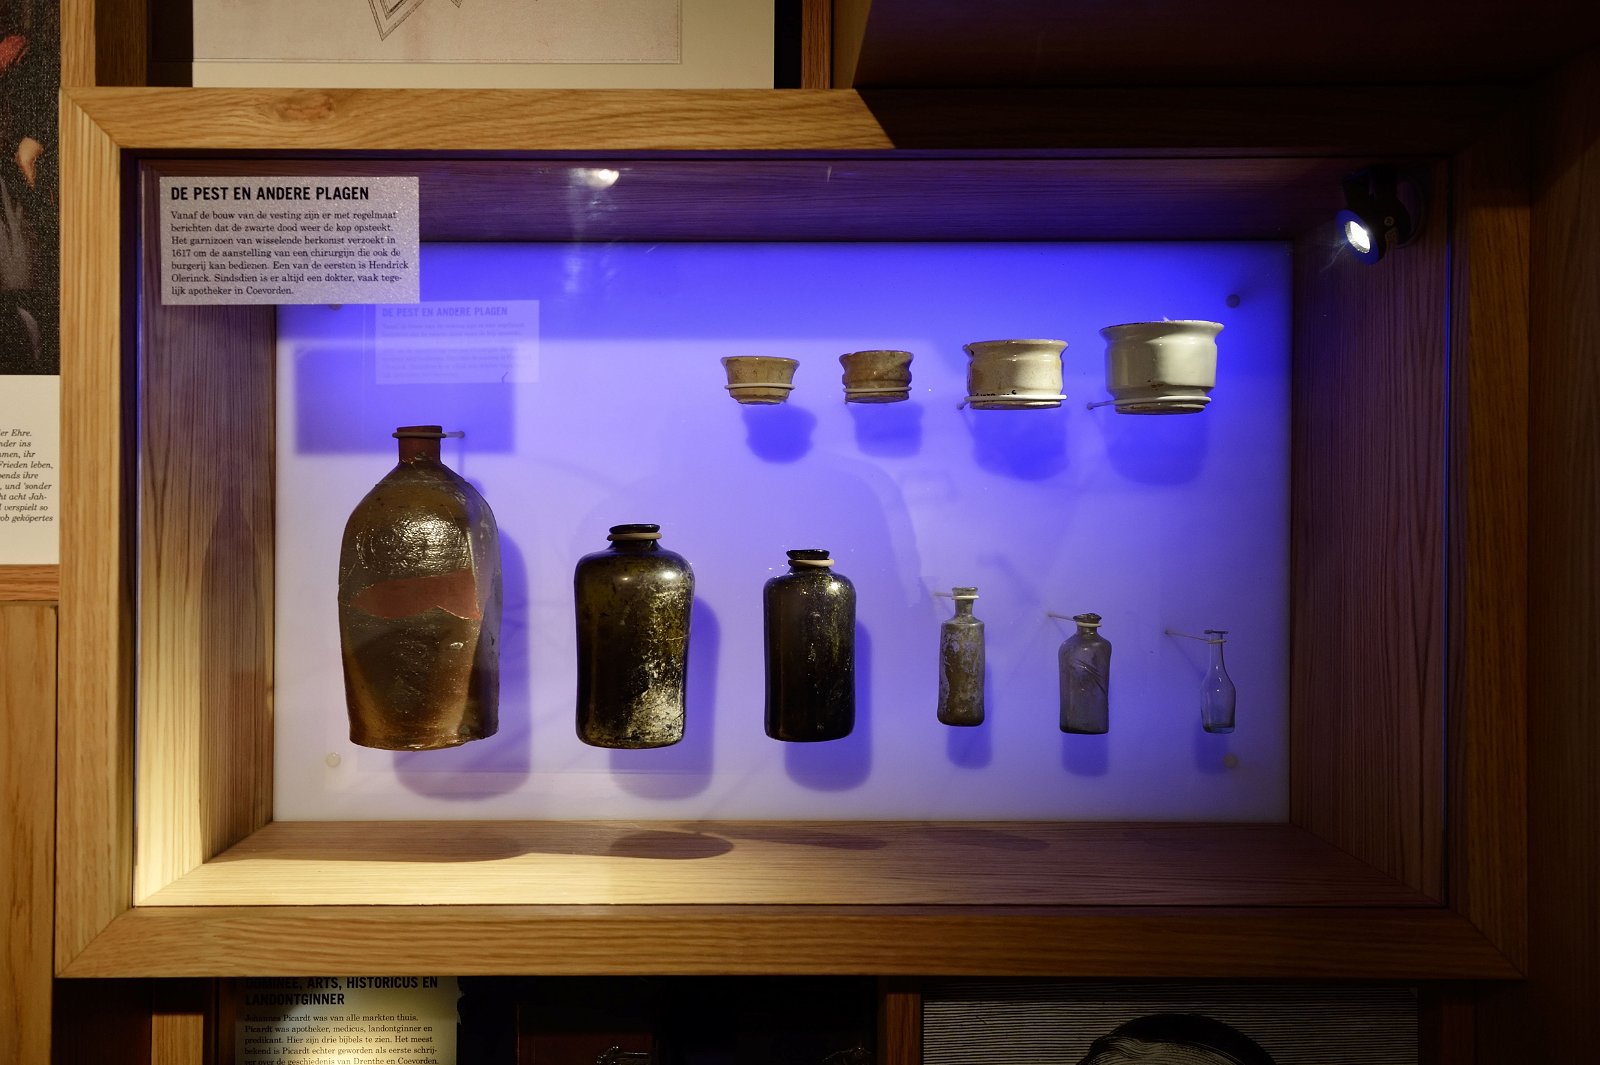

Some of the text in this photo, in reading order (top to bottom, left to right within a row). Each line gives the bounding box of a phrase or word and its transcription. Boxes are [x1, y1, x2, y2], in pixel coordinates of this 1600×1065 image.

[171, 187, 369, 200] DE PEST EN ANDERE PLAGEN
[171, 211, 198, 219] Vanaf
[200, 211, 210, 219] de
[212, 211, 235, 219] bouw
[257, 211, 267, 219] de
[270, 211, 301, 221] vesting
[304, 211, 319, 221] zijn
[353, 211, 397, 221] regelmaat
[171, 223, 212, 232] berichten
[214, 223, 229, 232] dat
[231, 223, 242, 232] de
[277, 223, 298, 232] dood
[324, 223, 333, 232] de
[336, 223, 351, 234] kop
[354, 223, 393, 234] opsteekt.
[171, 236, 187, 244] Het
[190, 236, 234, 246] garnizoen
[255, 236, 302, 244] wisselende
[304, 236, 344, 244] herkomst
[348, 236, 384, 244] verzoekt
[387, 236, 396, 244] in
[172, 248, 191, 257] 1617
[209, 248, 220, 257] de
[222, 248, 272, 259] aanstelling
[310, 248, 355, 259] chirurgijn
[358, 248, 370, 257] die
[373, 248, 388, 257] ook
[390, 248, 401, 257] de
[171, 261, 206, 271] burgerij
[209, 261, 226, 269] kan
[228, 261, 270, 269] bedienen.
[273, 261, 290, 269] Een
[311, 261, 321, 269] de
[359, 261, 366, 269] is
[369, 261, 409, 269] Hendrick
[171, 274, 210, 282] Olerinck.
[214, 274, 257, 282] Sindsdien
[260, 274, 267, 282] is
[281, 274, 304, 284] altijd
[324, 274, 355, 283] dokter,
[357, 274, 378, 282] vaak
[381, 275, 402, 284] tege-
[171, 286, 294, 296] lijk apotheker in Coevorden.
[31, 461, 53, 469] leben,
[4, 504, 37, 512] verspielt
[11, 514, 53, 523] geköpertes
[307, 977, 342, 990] ARTS,
[347, 976, 418, 988] HISTORICUS
[423, 976, 437, 988] EN
[246, 994, 344, 1005] LANDONTGINNER
[283, 1013, 311, 1021] Picardt
[346, 1013, 360, 1021] alle
[362, 1013, 394, 1021] markten
[397, 1013, 419, 1021] thuis.
[245, 1024, 272, 1032] Picardt
[291, 1024, 331, 1034] apotheker,
[333, 1024, 366, 1033] medicus,
[368, 1024, 421, 1034] landontginner
[245, 1035, 283, 1045] predikant.
[286, 1035, 304, 1043] Hier
[306, 1035, 320, 1045] zijn
[322, 1035, 337, 1043] drie
[339, 1034, 362, 1045] bijbels
[375, 1034, 392, 1043] zien.
[395, 1034, 409, 1043] Het
[244, 1046, 271, 1054] bekend
[274, 1046, 280, 1054] is
[282, 1046, 309, 1054] Picardt
[312, 1046, 335, 1054] echter
[338, 1045, 373, 1056] geworden
[375, 1045, 386, 1054] als
[414, 1045, 437, 1056] schrij-
